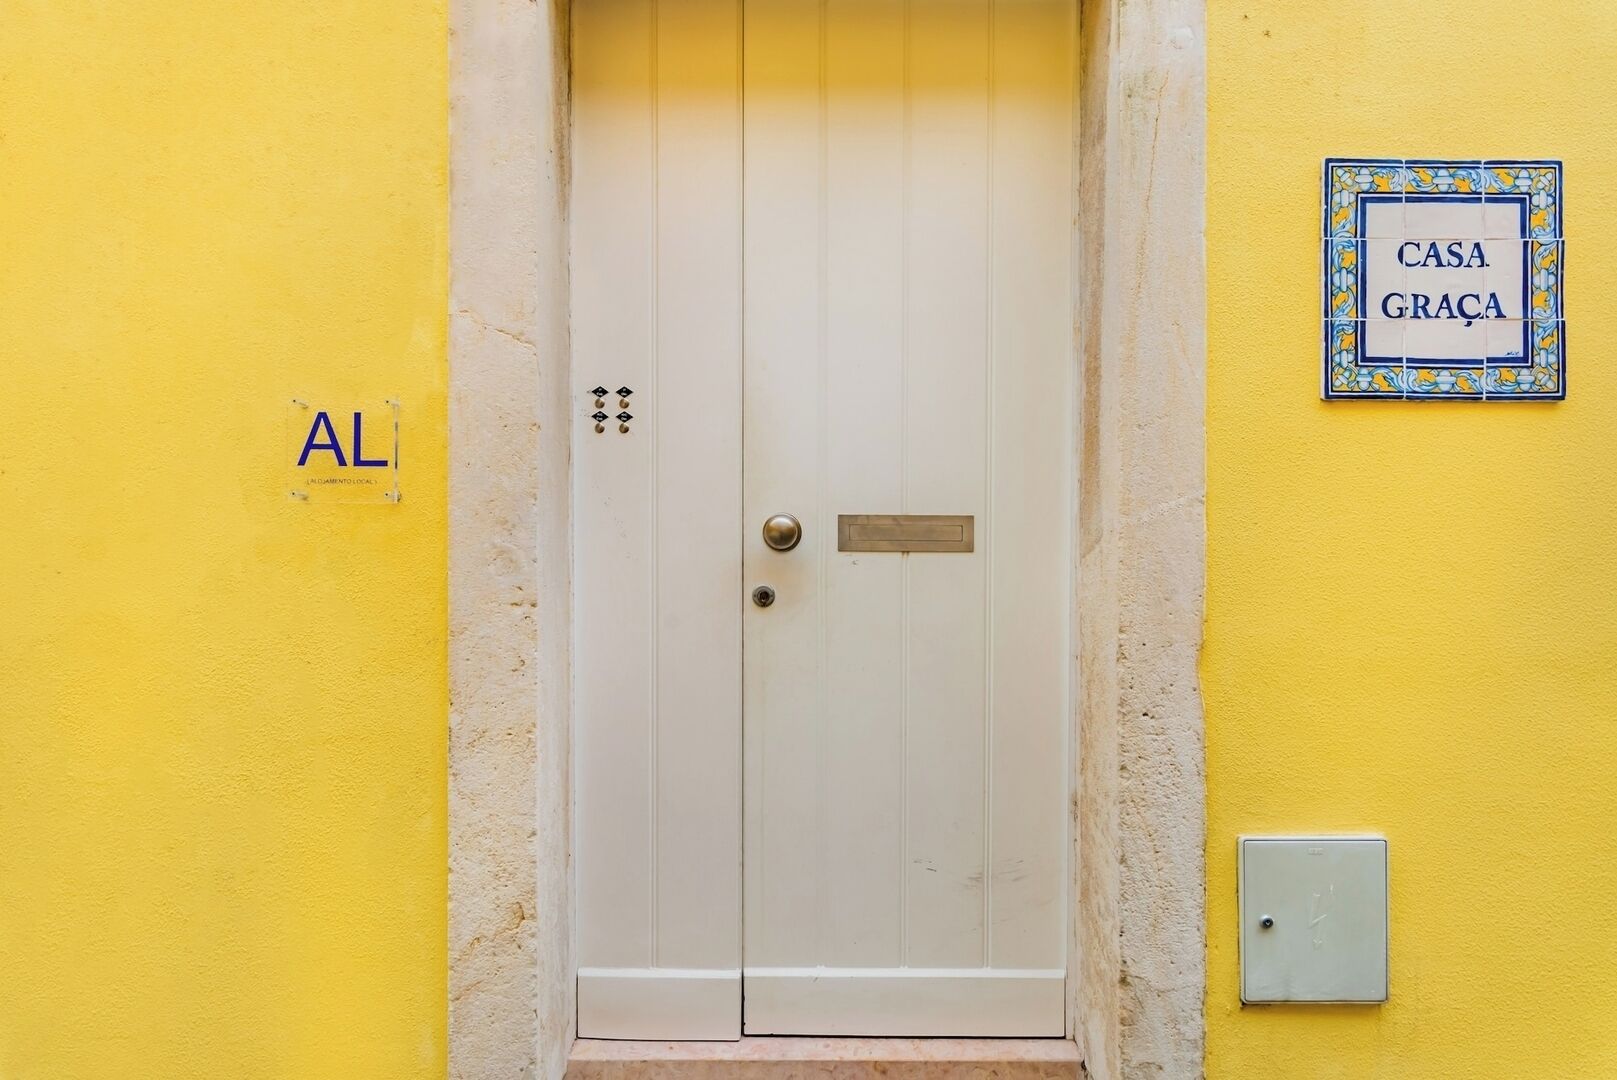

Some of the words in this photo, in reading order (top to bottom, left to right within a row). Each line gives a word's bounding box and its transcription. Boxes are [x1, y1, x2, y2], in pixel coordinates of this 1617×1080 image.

[1397, 241, 1490, 268] CASA
[1381, 292, 1507, 327] GRAÇA
[297, 411, 389, 467] AL
